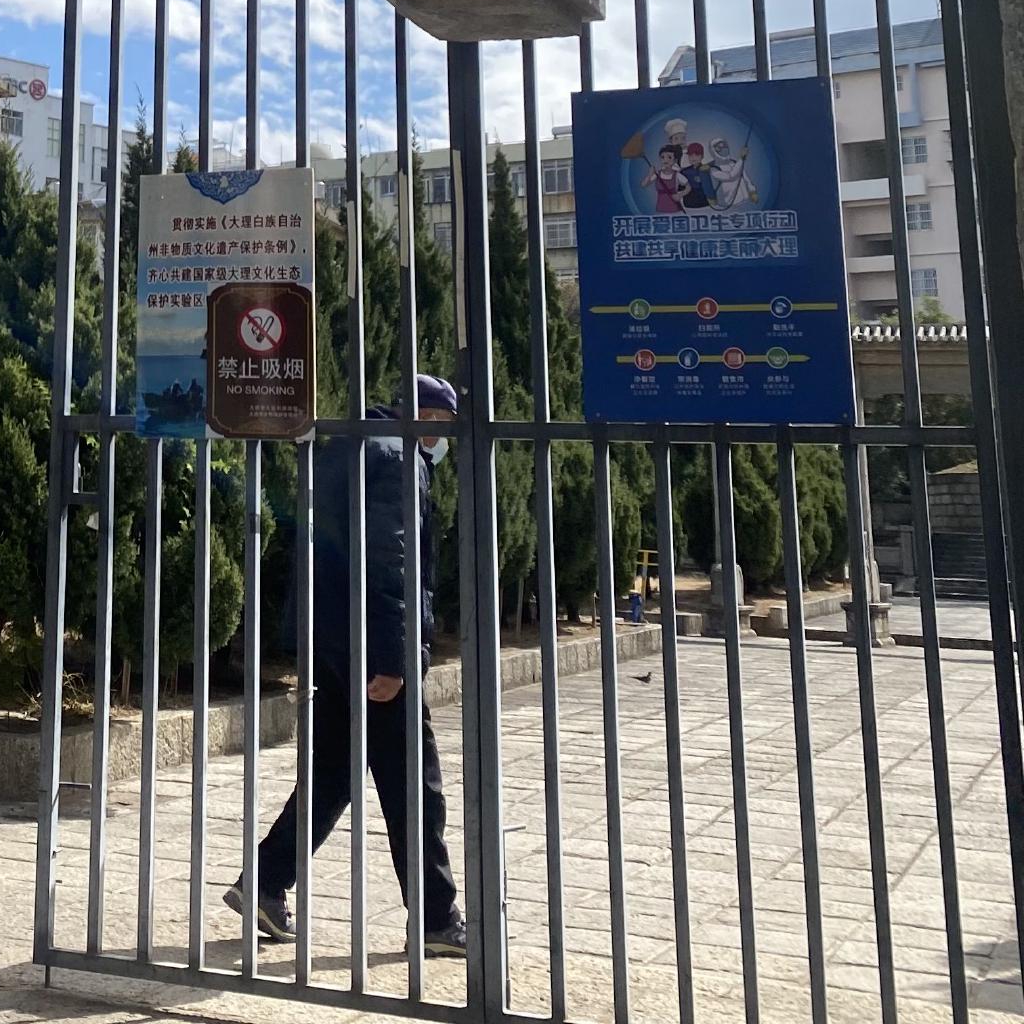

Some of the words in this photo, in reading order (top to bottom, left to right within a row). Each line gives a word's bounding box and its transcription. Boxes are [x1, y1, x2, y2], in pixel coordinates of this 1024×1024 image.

[172, 212, 302, 231] 贯彻实施《大理白族自治
[612, 210, 799, 237] 开展爱国卫生专项行动
[613, 236, 799, 263] 共建共享健康美丽大理
[147, 266, 301, 283] 齐心共建国家级大理文化生态
[147, 293, 204, 308] 保护实验区
[218, 356, 304, 380] 禁止吸烟
[226, 385, 243, 394] NO
[245, 385, 295, 396] SMOKING
